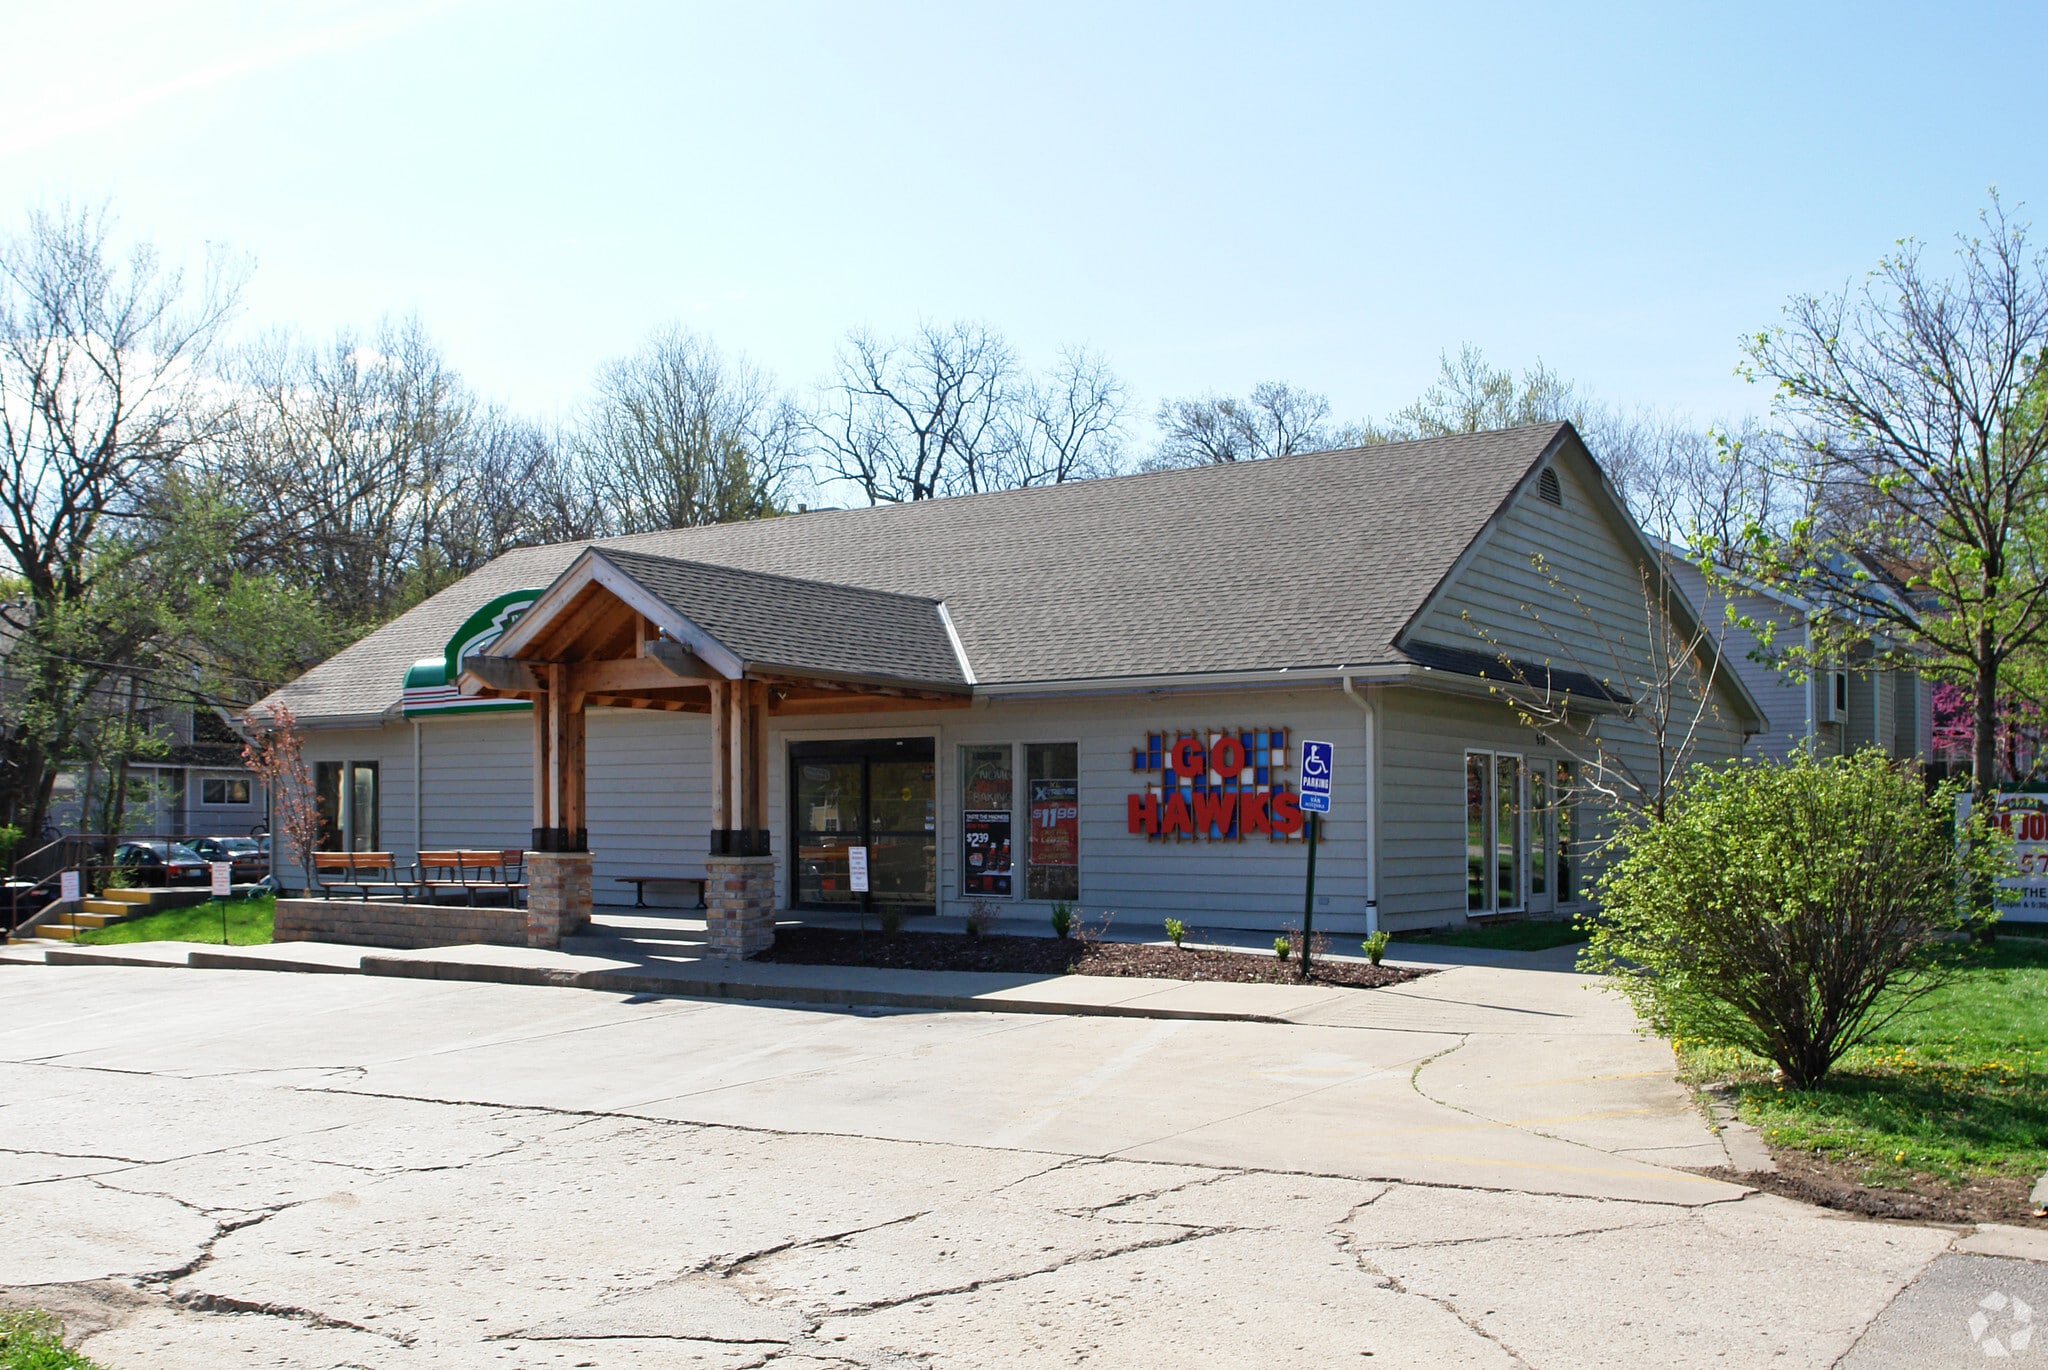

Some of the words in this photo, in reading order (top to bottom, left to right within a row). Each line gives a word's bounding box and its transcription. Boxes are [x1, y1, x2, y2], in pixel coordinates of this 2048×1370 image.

[1171, 737, 1246, 777] GO
[1303, 776, 1329, 789] PARKING
[1310, 796, 1321, 804] VAN
[1127, 791, 1303, 834] HAWKS
[2021, 887, 2047, 898] THE
